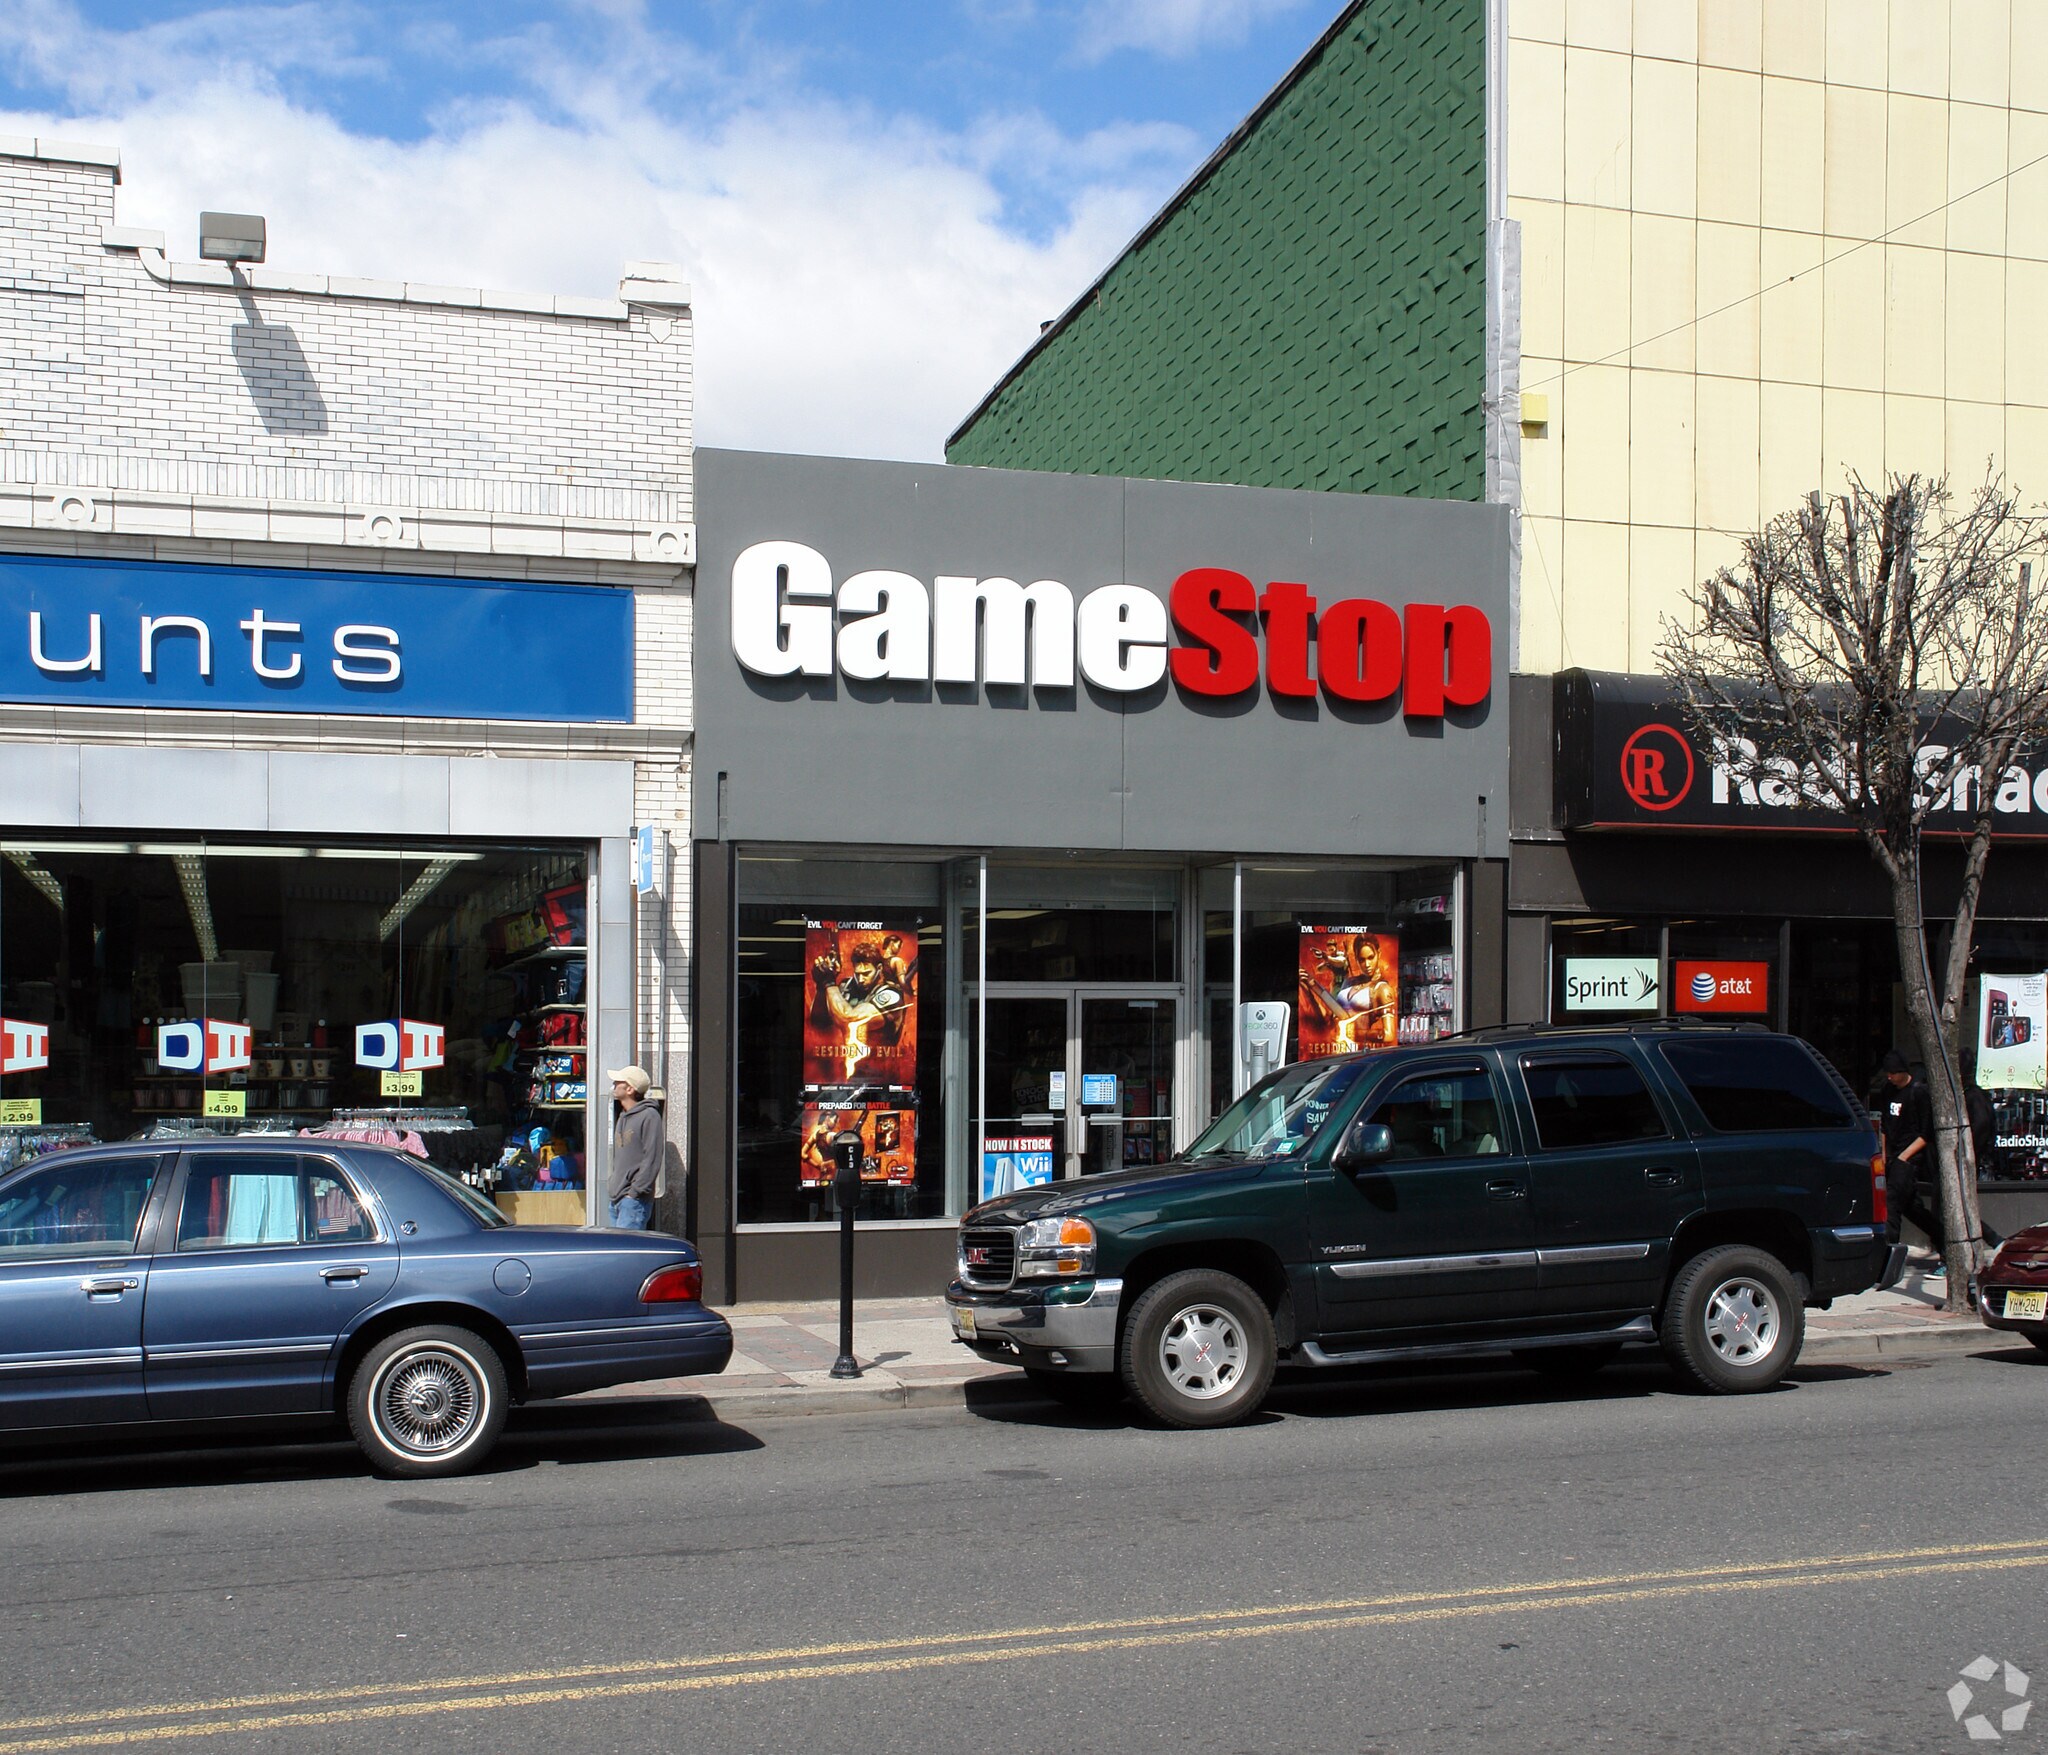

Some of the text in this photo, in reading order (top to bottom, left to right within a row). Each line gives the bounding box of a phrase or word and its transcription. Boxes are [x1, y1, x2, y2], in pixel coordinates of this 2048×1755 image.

[730, 539, 1493, 719] GameStop
[29, 608, 404, 685] unts
[807, 920, 883, 930] EVIL YOU CAN'T FORGET
[1301, 925, 1368, 934] EVIL YOU CAN'T FORGET
[1567, 975, 1629, 1003] Sprint
[1719, 977, 1752, 994] at&t
[1263, 1022, 1278, 1030] 360
[814, 1045, 904, 1058] RESIDENT EVIL
[386, 1084, 415, 1093] $3.99
[208, 1104, 238, 1114] $4.99
[804, 1101, 891, 1110] GET PREPARED FOR BATTLE
[2, 1112, 34, 1122] $2.99
[1306, 1111, 1329, 1124] SAV
[985, 1138, 1052, 1151] NOW IN STOCK
[1994, 1134, 2048, 1148] RadioSha
[1020, 1156, 1050, 1173] Wii
[1321, 1244, 1366, 1254] YUKON
[966, 1248, 988, 1264] GMC
